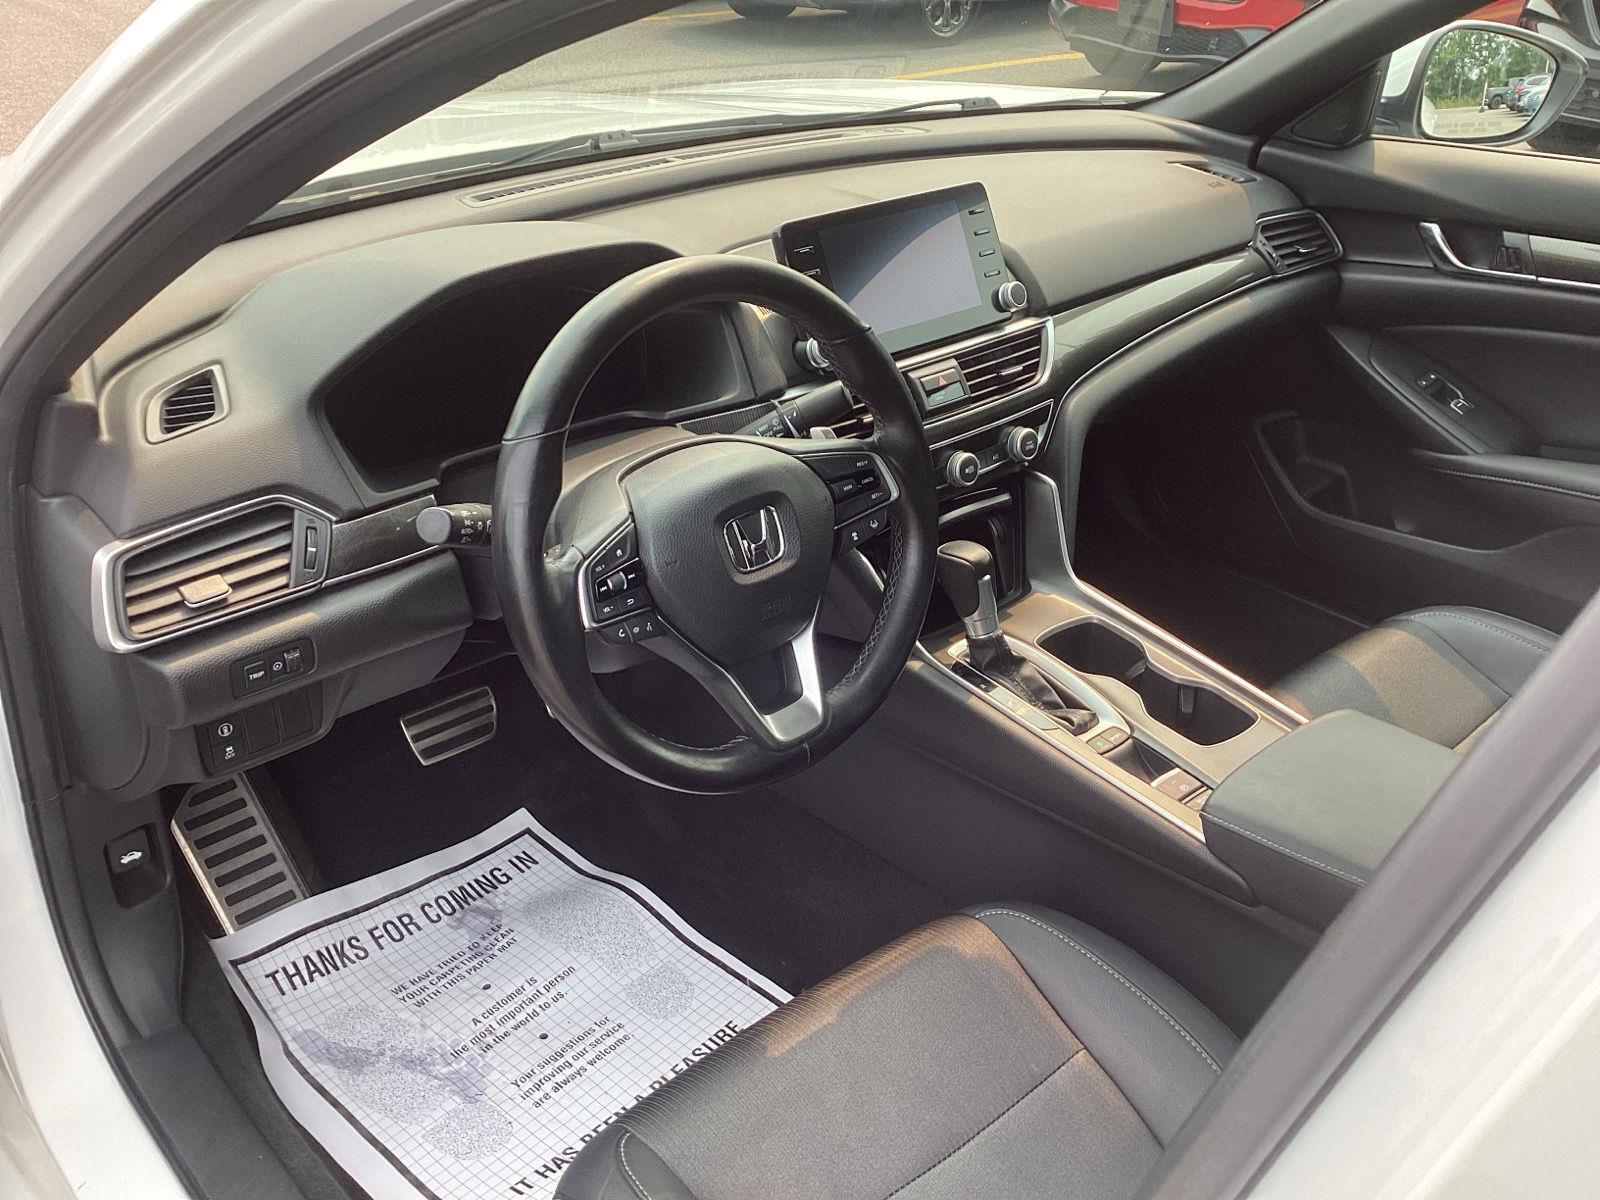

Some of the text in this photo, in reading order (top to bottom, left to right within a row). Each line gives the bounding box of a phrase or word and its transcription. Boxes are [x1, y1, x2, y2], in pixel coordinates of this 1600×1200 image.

[249, 671, 265, 680] TRIP
[264, 850, 540, 997] THANKS FOR COMING IN
[390, 923, 503, 995] WE HAVE TRIED TO KEEP
[398, 927, 515, 1003] YOUR CARPETING CLEAN
[413, 936, 518, 1009] WITH THIS PAPER MAT
[471, 976, 538, 1026] A customer is
[449, 965, 576, 1059] the most important person
[480, 1042, 494, 1054] in
[492, 1029, 511, 1044] the
[510, 1009, 540, 1031] world
[538, 1001, 551, 1011] to
[510, 1016, 611, 1089] Your suggestions for
[518, 1022, 625, 1101] improving our service
[532, 1092, 552, 1109] are
[551, 1065, 588, 1094] always
[509, 1177, 534, 1196] IT
[534, 1147, 580, 1179] HAS
